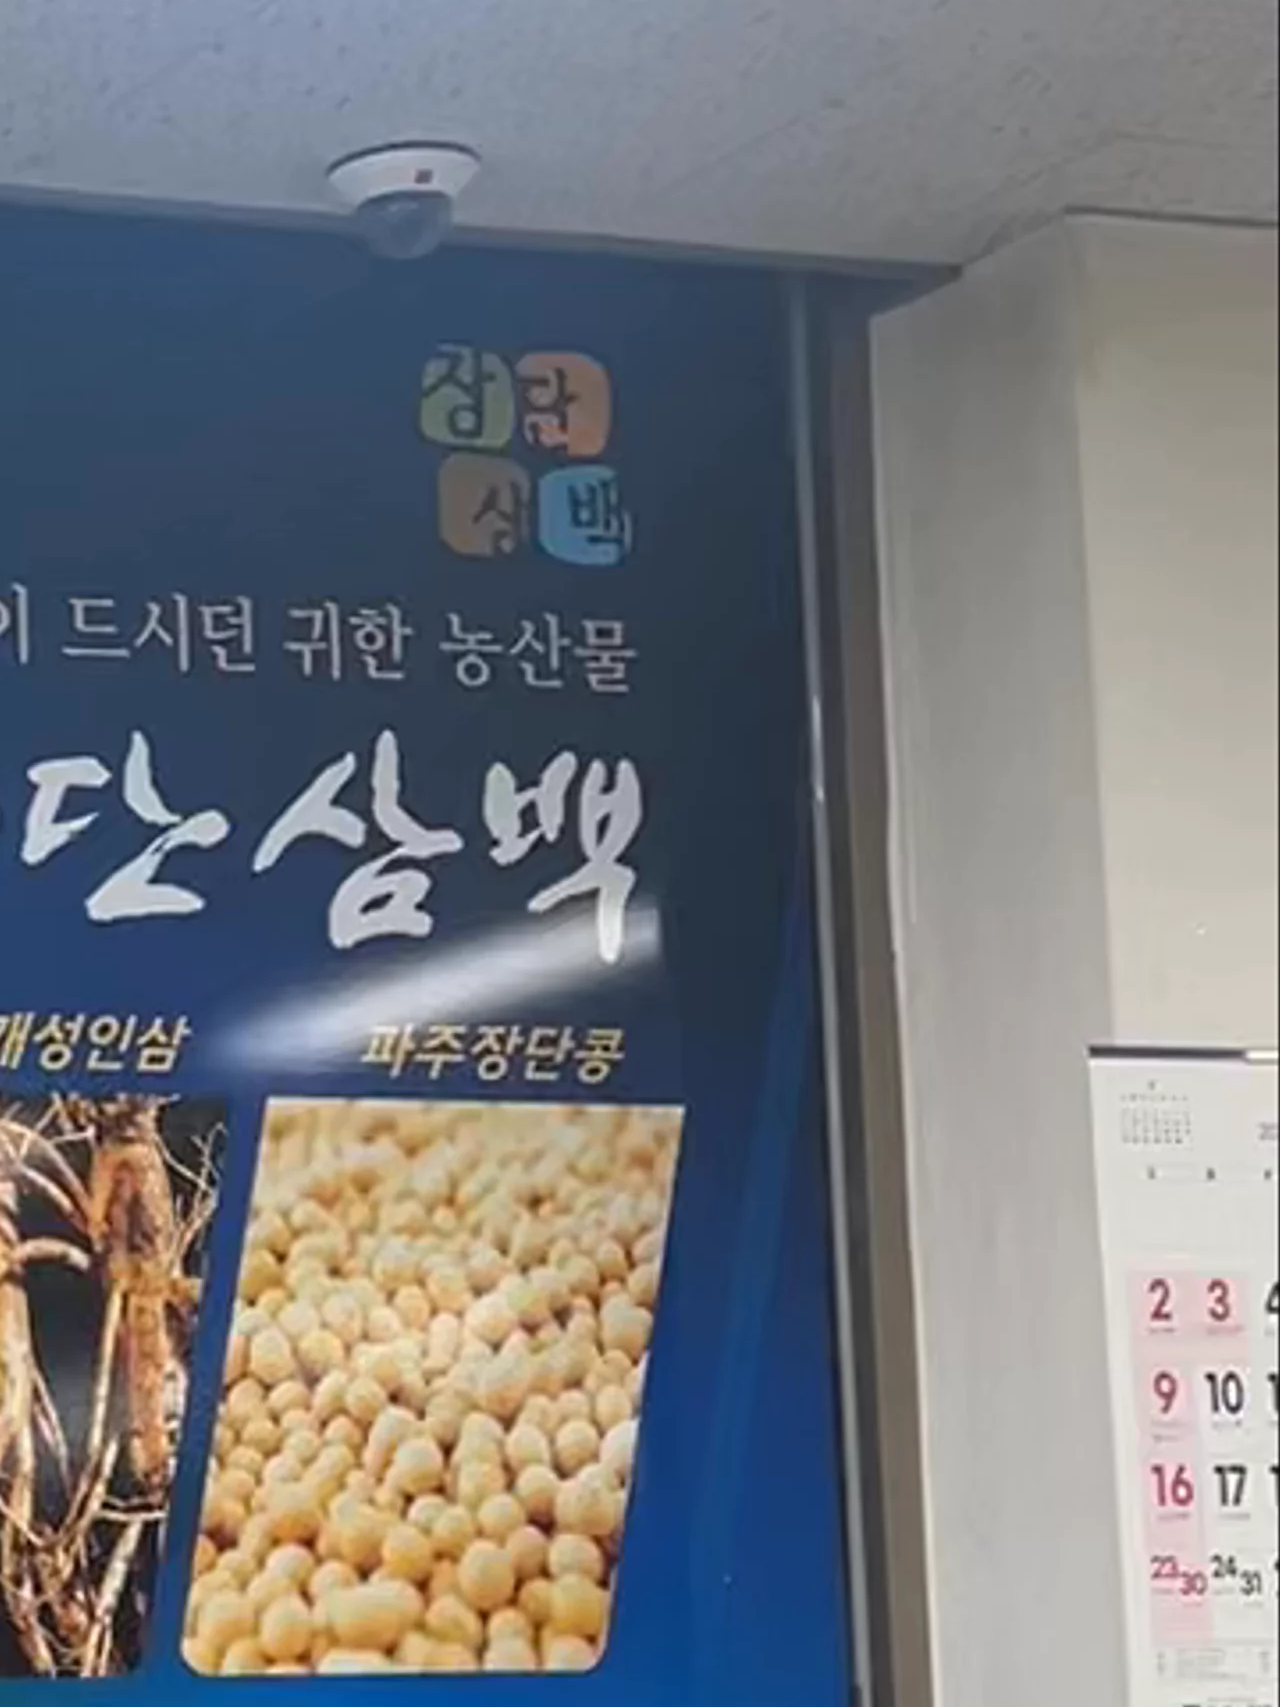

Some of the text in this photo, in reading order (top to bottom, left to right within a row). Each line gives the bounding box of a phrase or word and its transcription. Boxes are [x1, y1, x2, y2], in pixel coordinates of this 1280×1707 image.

[61, 592, 256, 673] 드시던
[285, 600, 414, 681] 귀한
[439, 612, 636, 693] 농산물
[361, 1024, 627, 1084] 파주장단콩
[1149, 1277, 1172, 1321] 2
[1207, 1277, 1230, 1322] 3
[1153, 1371, 1177, 1414] 9
[1204, 1371, 1244, 1414] 10
[1151, 1464, 1194, 1506] 16
[1213, 1464, 1247, 1506] 17
